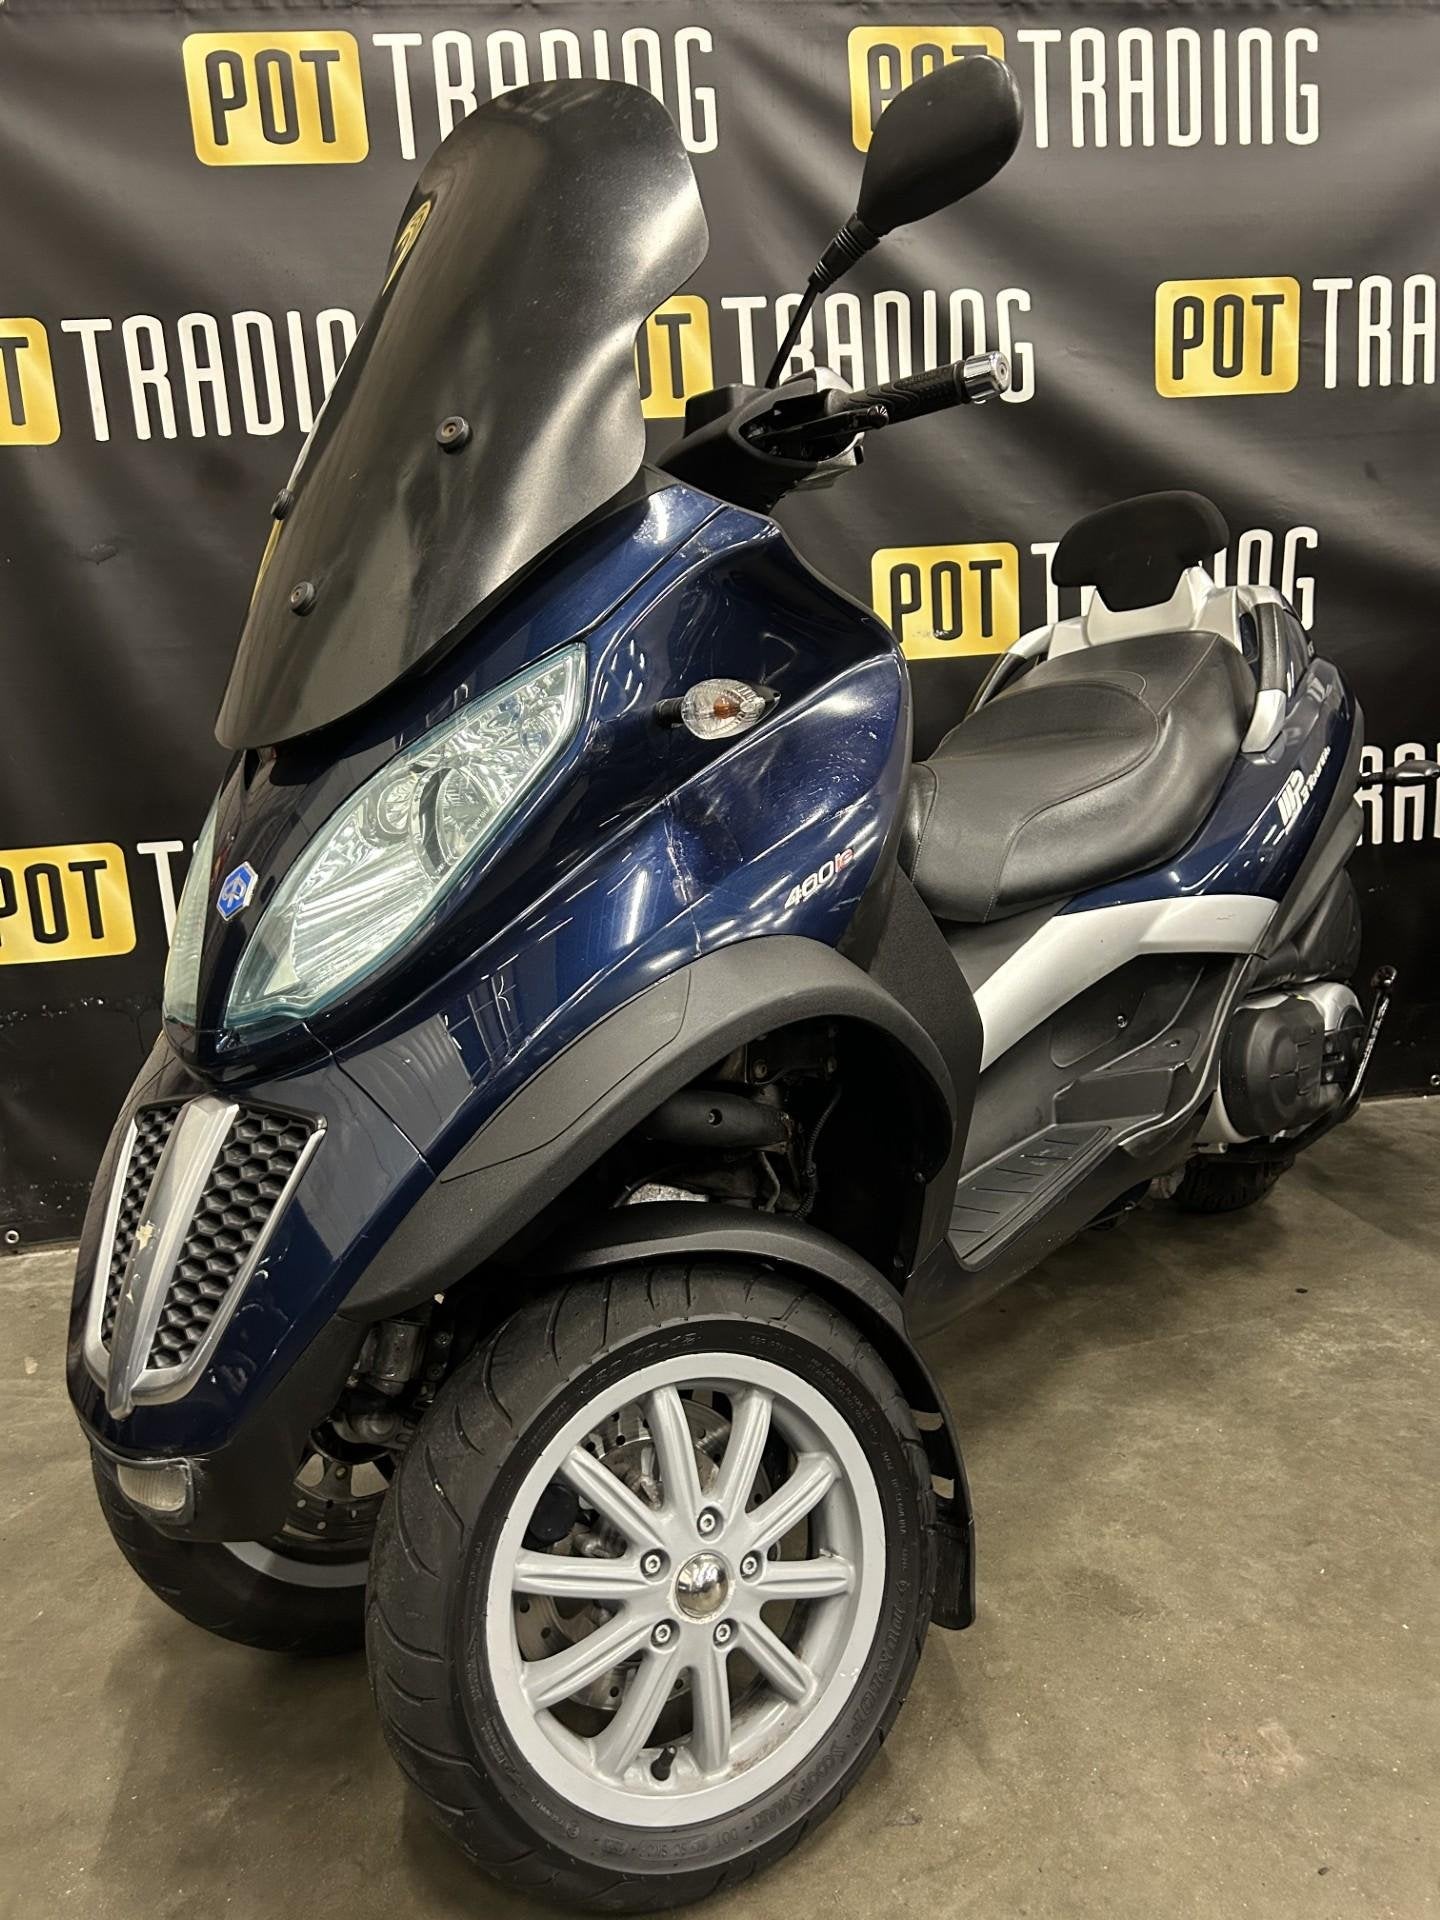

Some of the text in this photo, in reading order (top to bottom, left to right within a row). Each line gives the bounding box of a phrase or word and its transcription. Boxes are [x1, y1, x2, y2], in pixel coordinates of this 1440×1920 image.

[206, 49, 340, 146] POT
[1017, 27, 1319, 148] TRADING
[1172, 294, 1285, 380] POT
[890, 559, 1003, 643] POT
